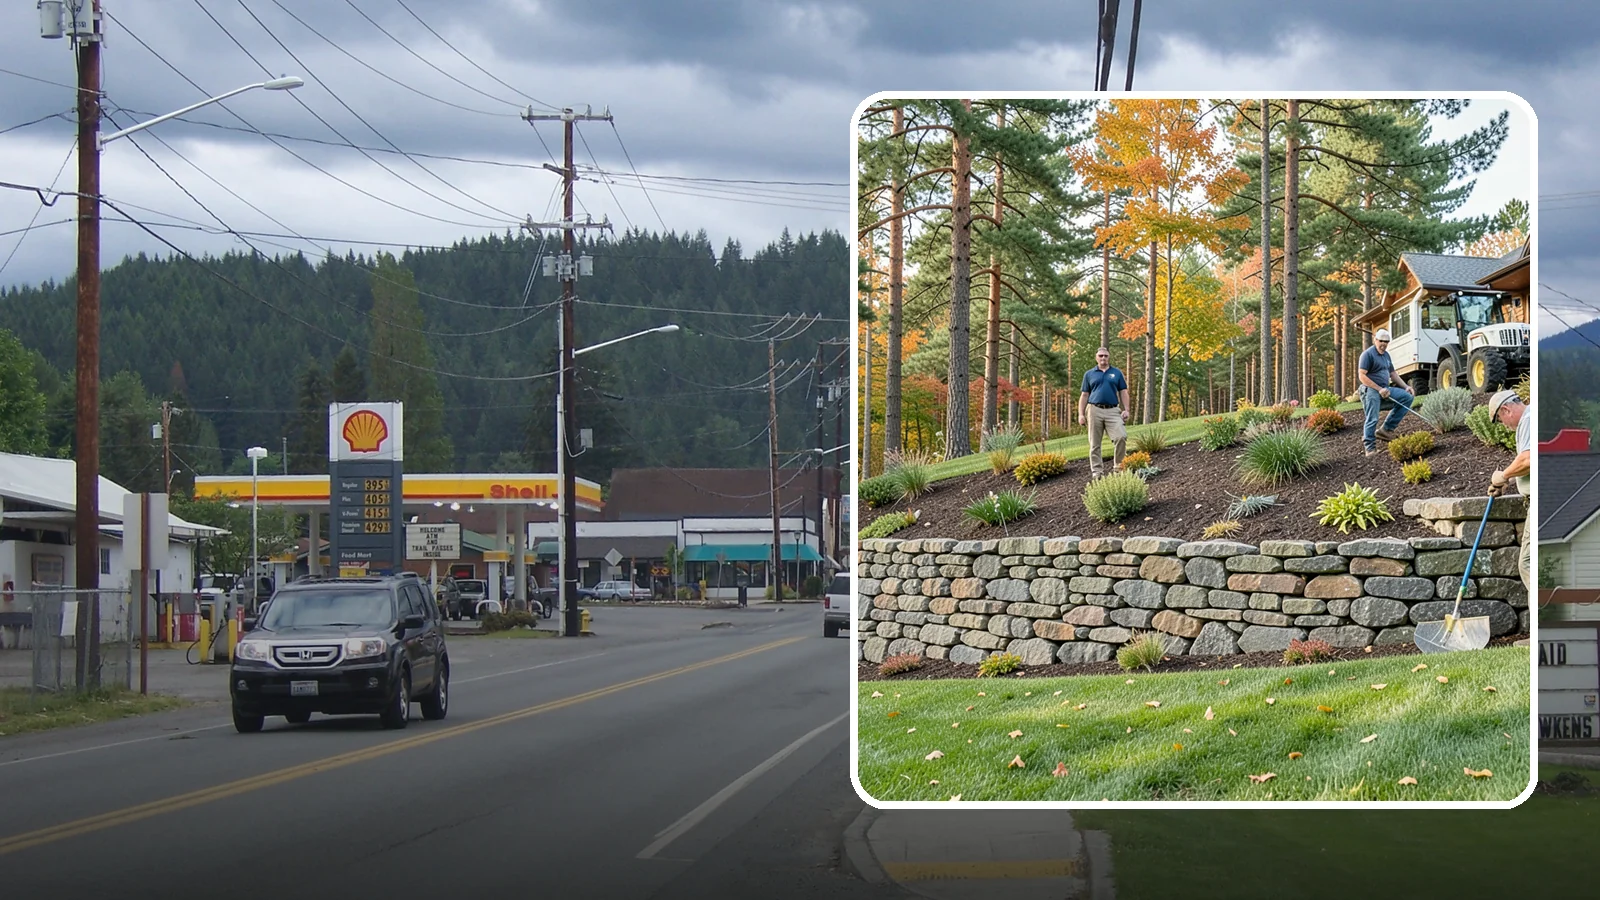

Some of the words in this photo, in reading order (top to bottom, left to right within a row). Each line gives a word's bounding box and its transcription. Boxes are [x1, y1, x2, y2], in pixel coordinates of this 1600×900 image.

[366, 480, 384, 490] 395
[490, 484, 548, 498] Shell
[366, 494, 384, 504] 405
[366, 508, 384, 518] 415
[366, 522, 384, 532] 429
